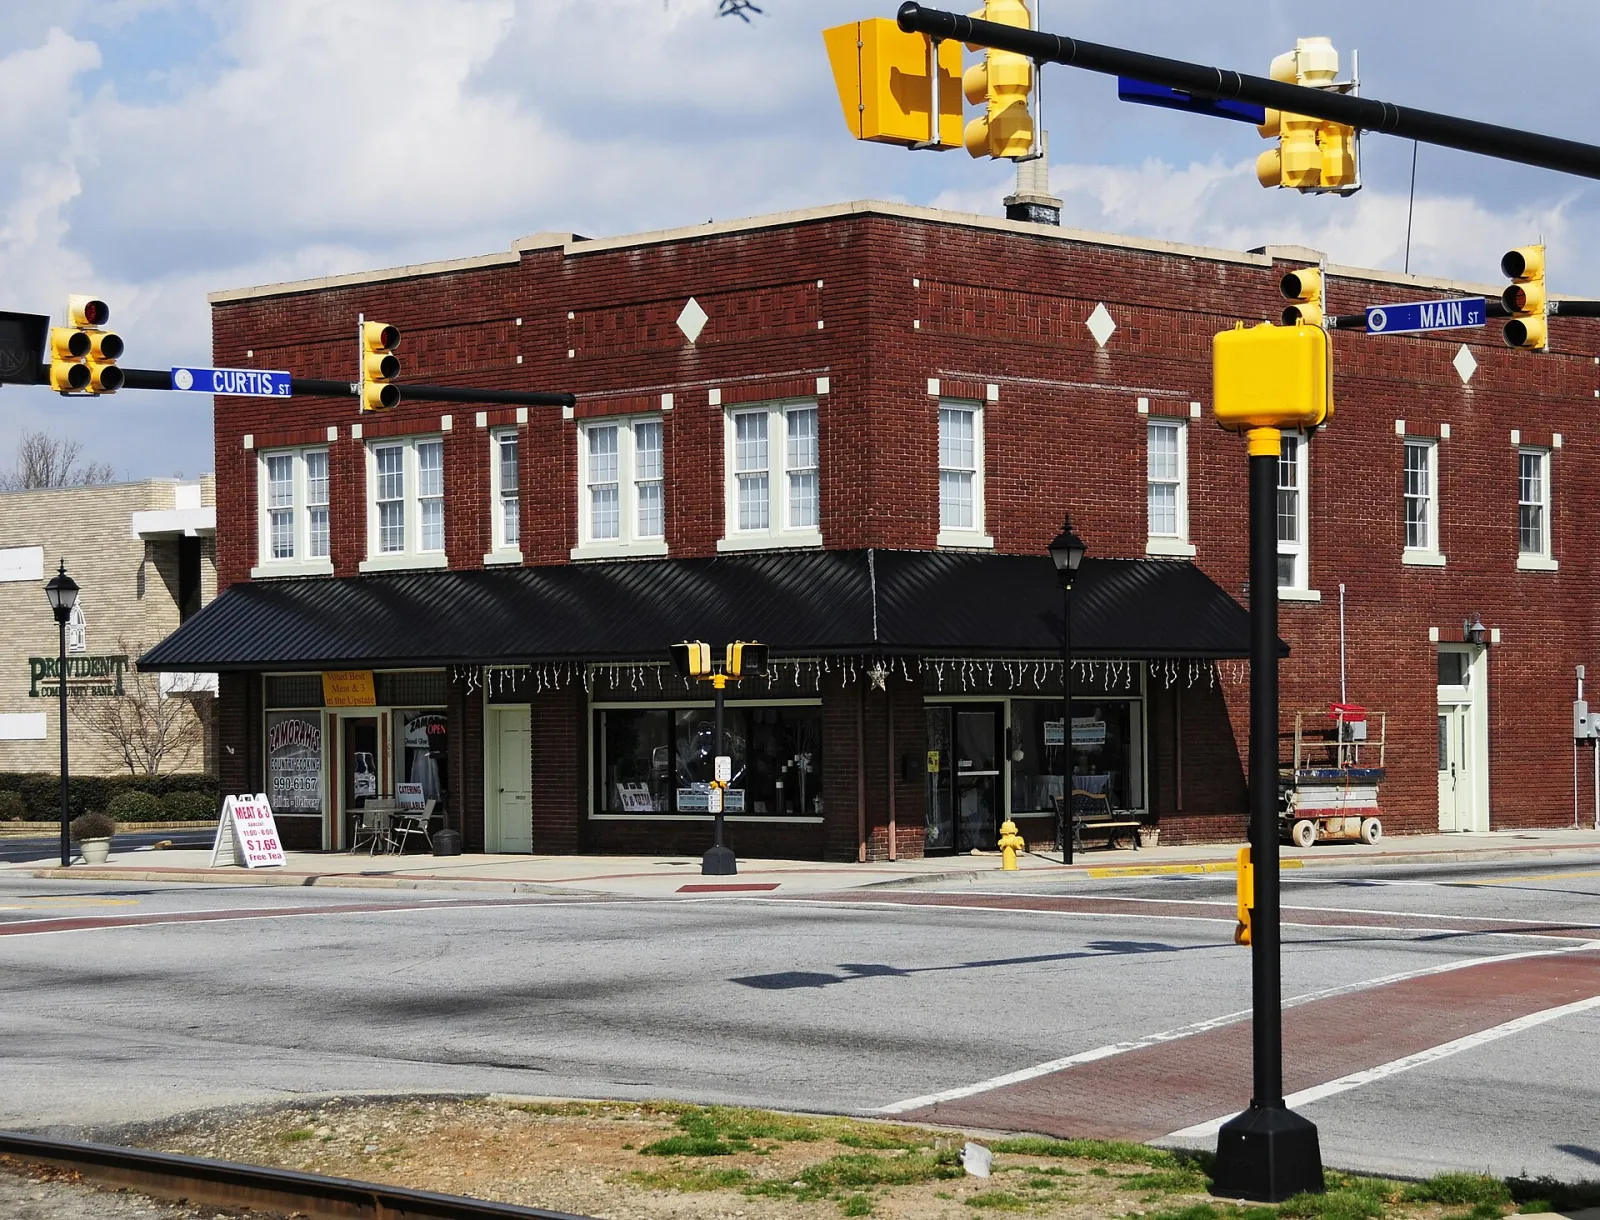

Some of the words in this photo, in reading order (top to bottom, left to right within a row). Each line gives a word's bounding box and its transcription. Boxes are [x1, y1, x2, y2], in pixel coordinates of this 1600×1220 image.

[1420, 302, 1462, 328] MAIN
[1467, 311, 1479, 324] ST
[213, 371, 273, 394] CURTIS
[278, 384, 290, 394] ST
[326, 672, 348, 680] Voted
[349, 672, 366, 680] Best
[41, 686, 88, 697] COMUNITY
[332, 684, 350, 692] Meat
[352, 684, 359, 692] &
[360, 684, 366, 692] 3
[335, 696, 346, 704] the
[347, 696, 375, 706] Upstate
[427, 724, 446, 735] OPEN
[270, 720, 321, 753] ZAMORAH'S
[273, 777, 317, 791] 990-6167
[399, 786, 421, 794] CATERING
[235, 806, 255, 820] MEAT
[256, 808, 263, 818] &
[263, 805, 270, 818] 3
[255, 839, 277, 850] 7.69
